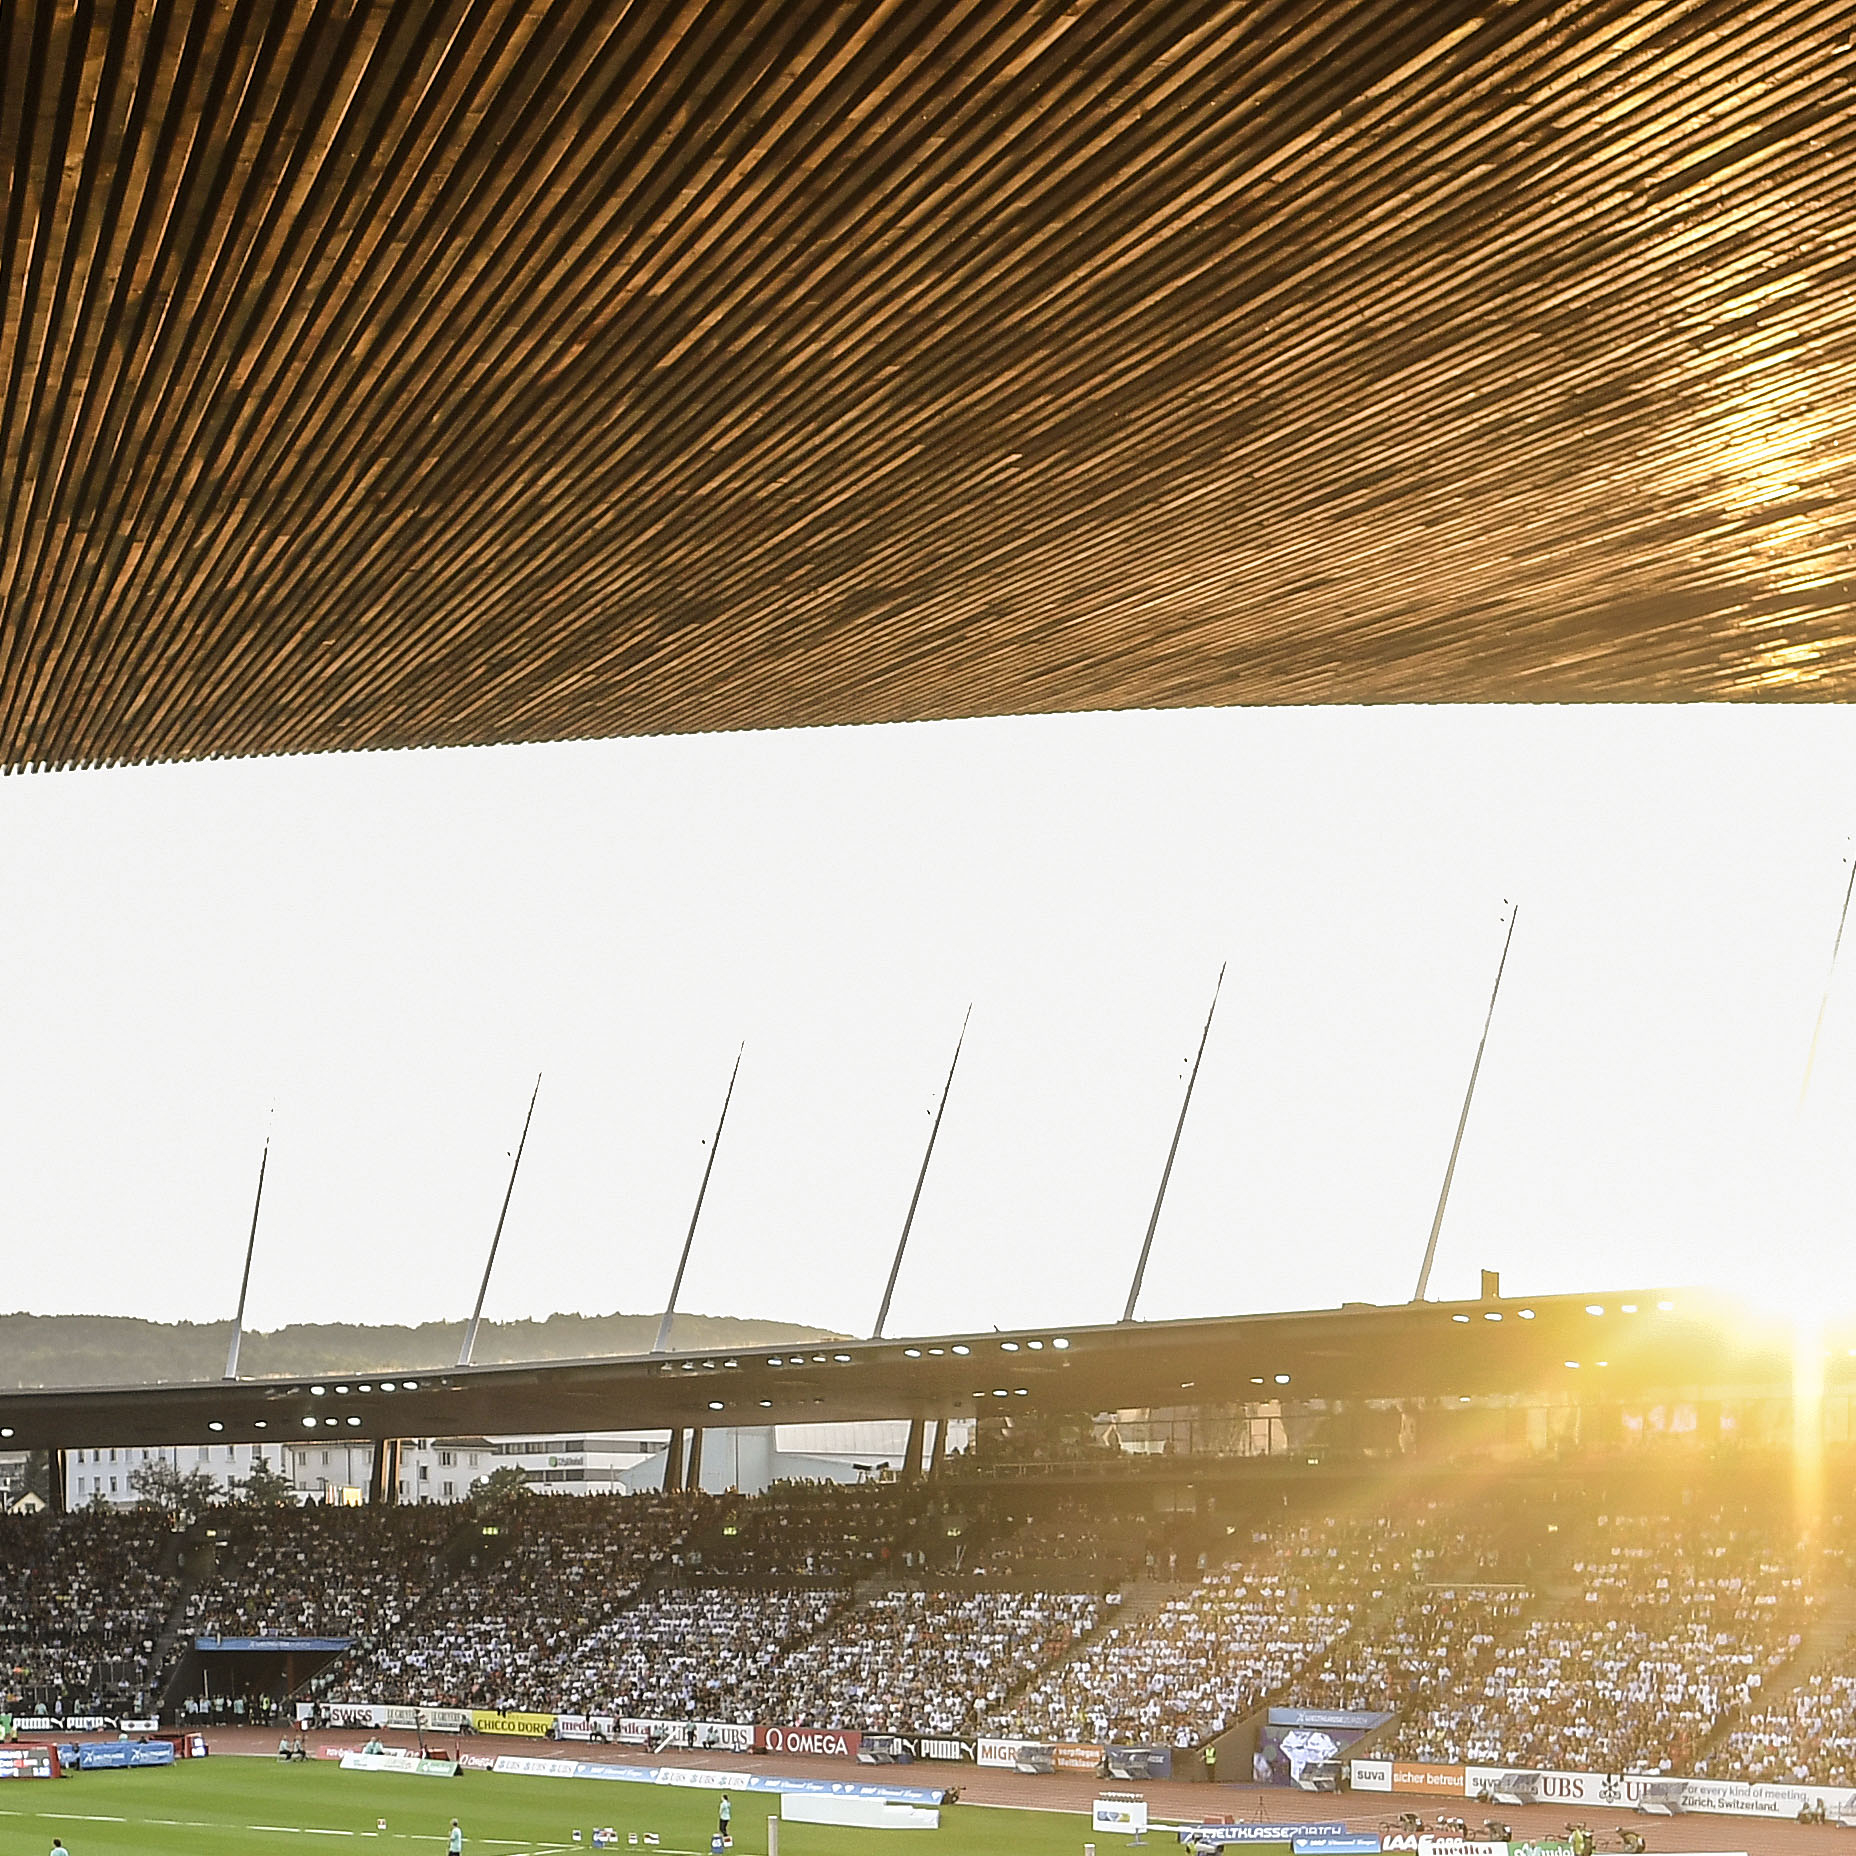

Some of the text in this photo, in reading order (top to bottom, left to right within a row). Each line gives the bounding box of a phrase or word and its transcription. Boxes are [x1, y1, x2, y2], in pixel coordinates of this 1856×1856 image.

[477, 1719, 515, 1732] CHICCO
[787, 1732, 848, 1756] OMEGA
[921, 1739, 962, 1760] PUMA
[1357, 1770, 1385, 1781] suva
[1393, 1770, 1464, 1786] sicher betreut
[1543, 1776, 1584, 1798] UBS
